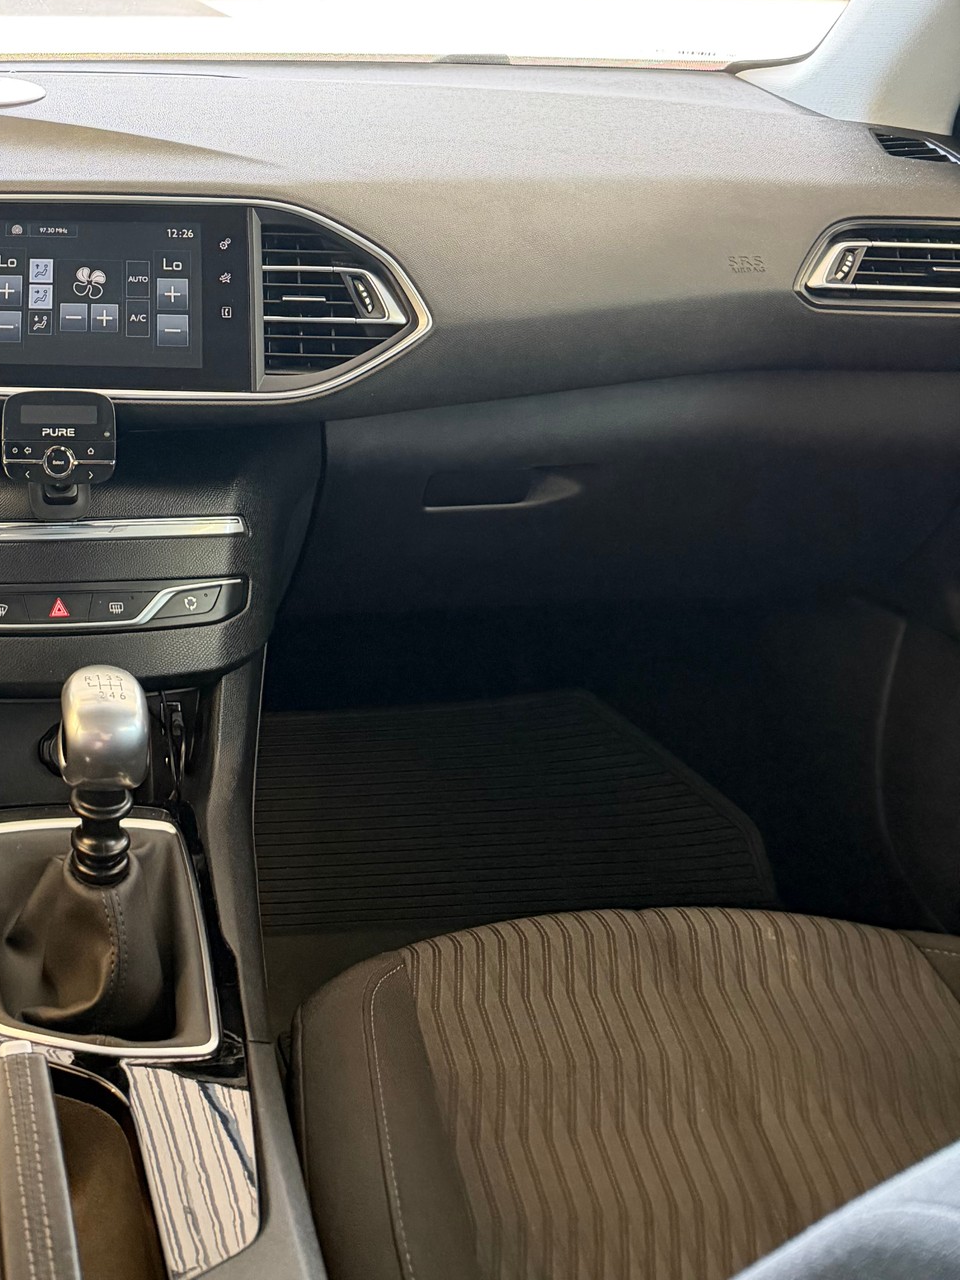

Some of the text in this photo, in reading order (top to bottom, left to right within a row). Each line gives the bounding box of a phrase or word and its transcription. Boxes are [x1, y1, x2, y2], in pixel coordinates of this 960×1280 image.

[167, 229, 194, 238] 12:26
[163, 257, 182, 271] Lo
[129, 314, 147, 322] A/C
[42, 428, 76, 437] PURE
[106, 673, 112, 681] 3
[99, 690, 127, 700] 2 4 6
